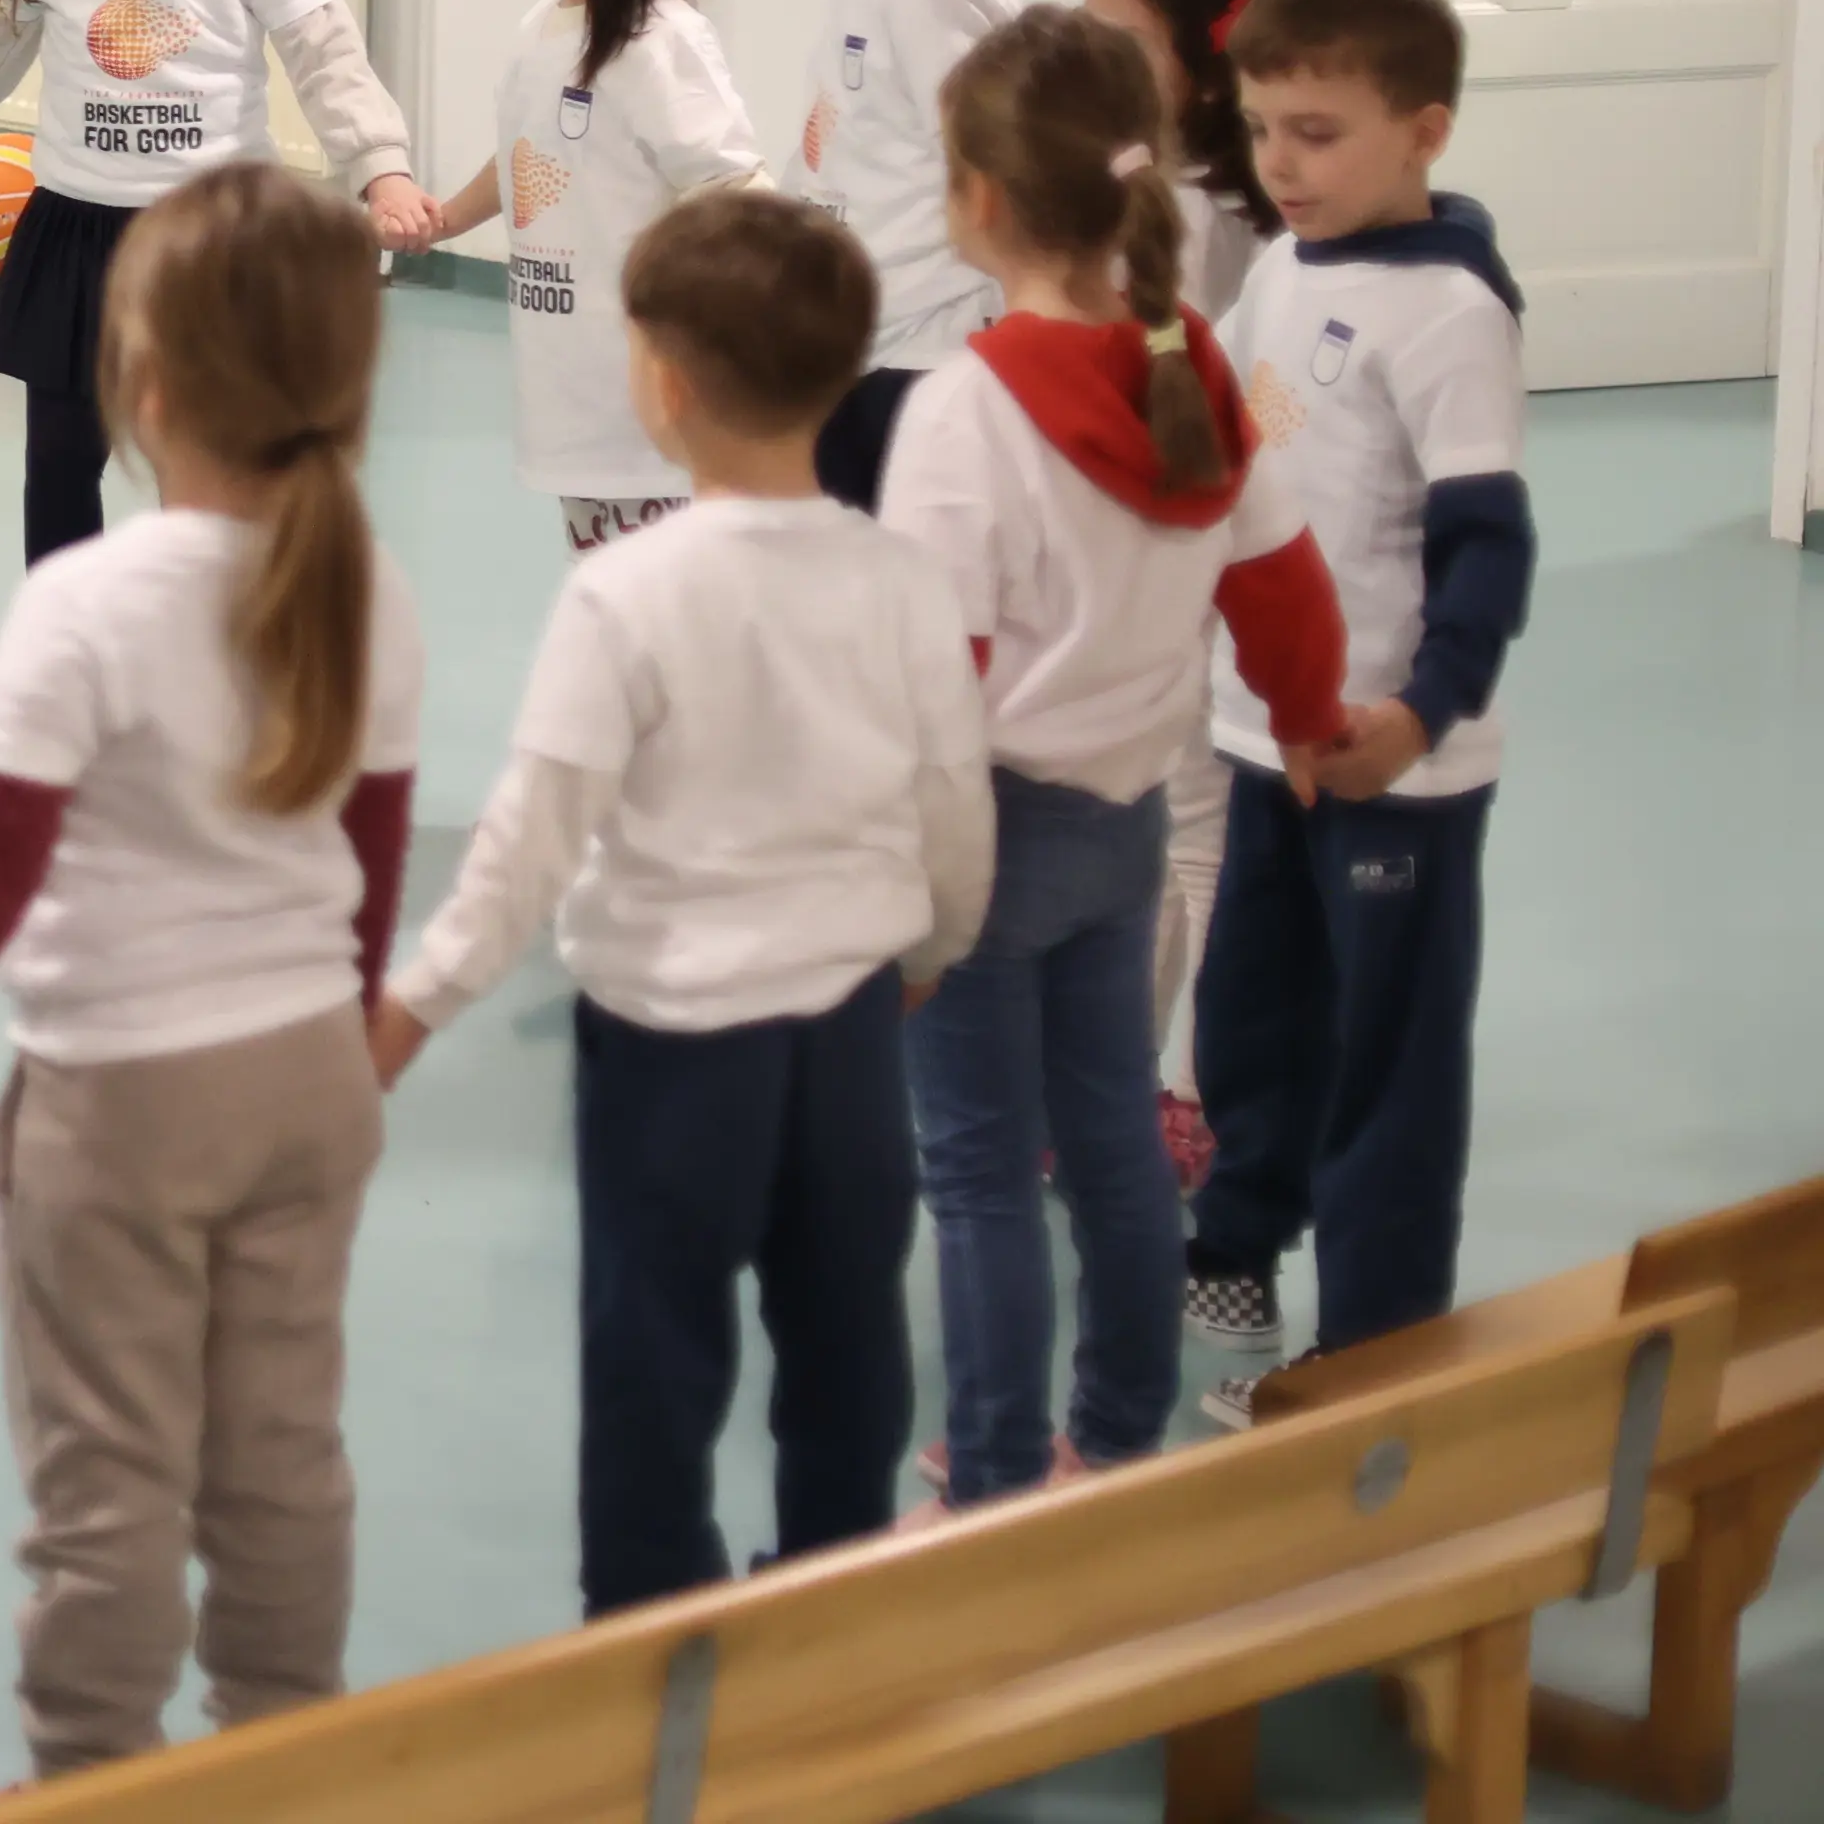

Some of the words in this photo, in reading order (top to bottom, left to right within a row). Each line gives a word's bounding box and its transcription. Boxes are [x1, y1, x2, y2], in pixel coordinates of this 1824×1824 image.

[84, 102, 203, 125] BASKETBALL
[84, 125, 129, 153] FOR
[136, 126, 203, 154] GOOD
[520, 282, 575, 314] GOOD
